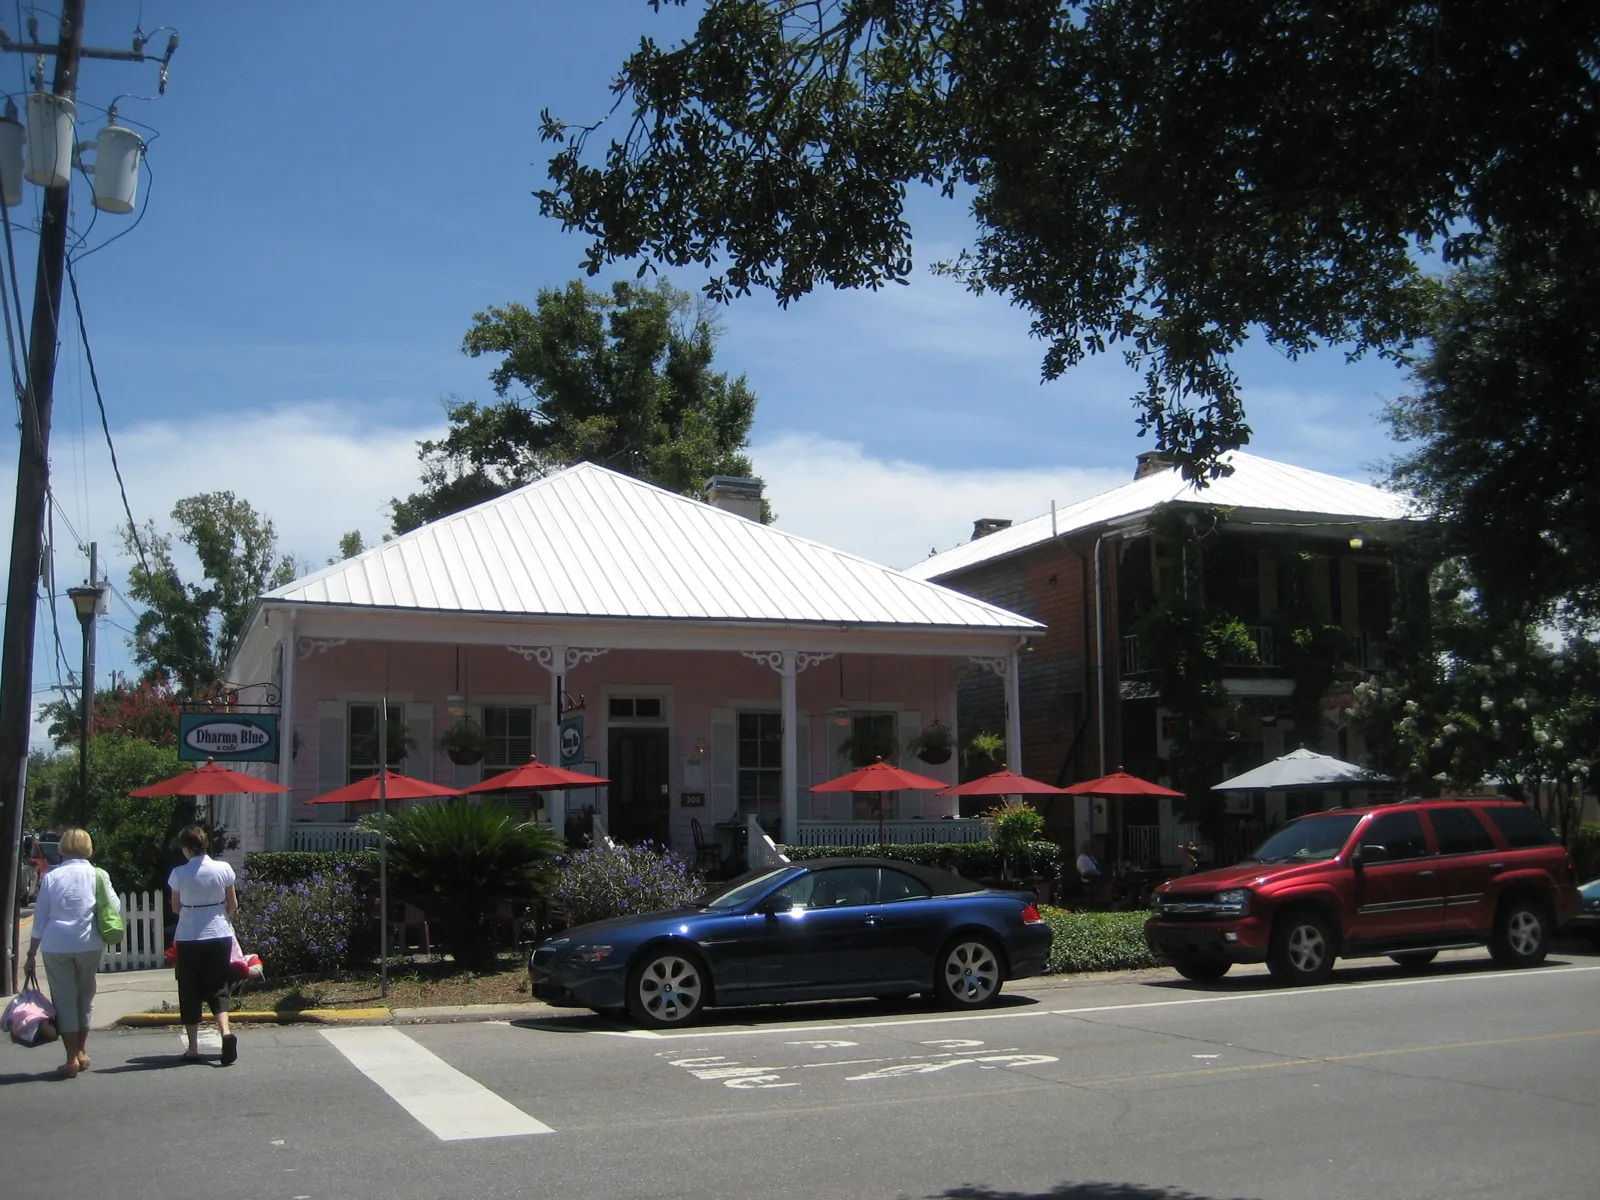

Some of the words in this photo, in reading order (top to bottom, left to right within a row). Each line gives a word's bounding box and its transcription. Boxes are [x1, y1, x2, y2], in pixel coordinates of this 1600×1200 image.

[196, 729, 237, 744] Dharma
[240, 730, 264, 744] Blue
[686, 796, 701, 804] 300
